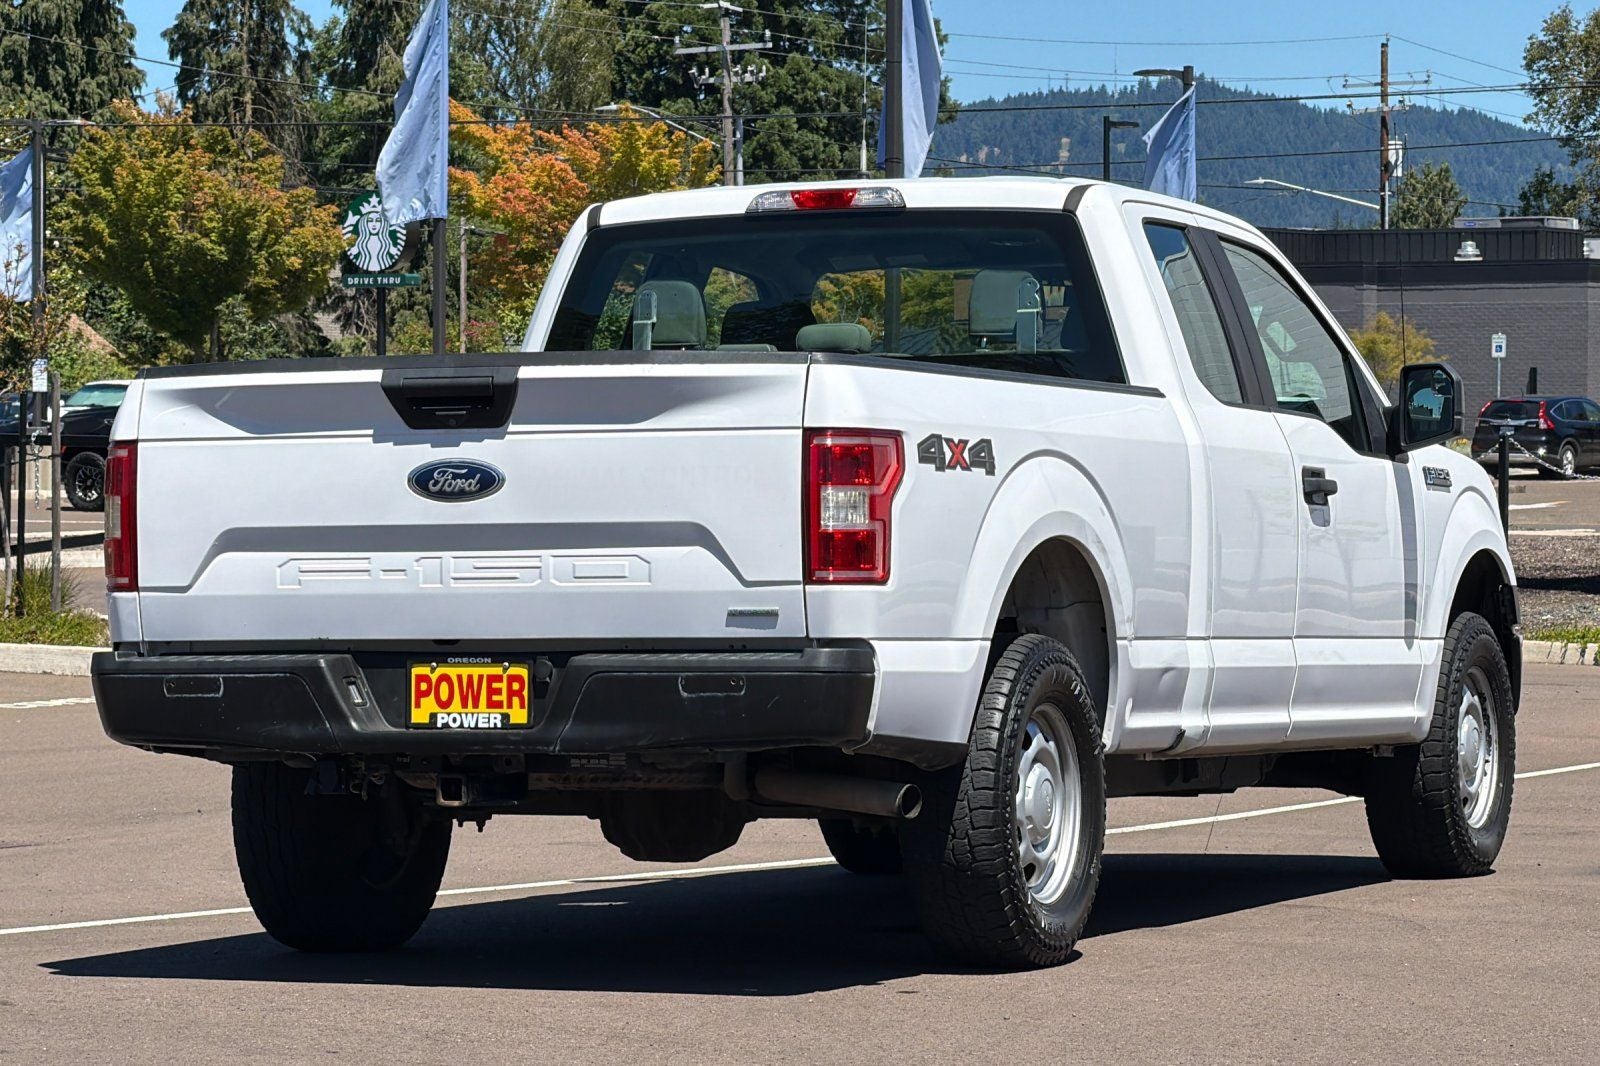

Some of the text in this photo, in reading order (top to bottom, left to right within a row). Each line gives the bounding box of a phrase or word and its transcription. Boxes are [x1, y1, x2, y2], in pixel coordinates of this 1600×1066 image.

[347, 277, 374, 285] DRIVE
[428, 467, 481, 493] Ford
[276, 554, 652, 589] F-150
[414, 673, 526, 710] POWER
[436, 713, 502, 728] POWER
